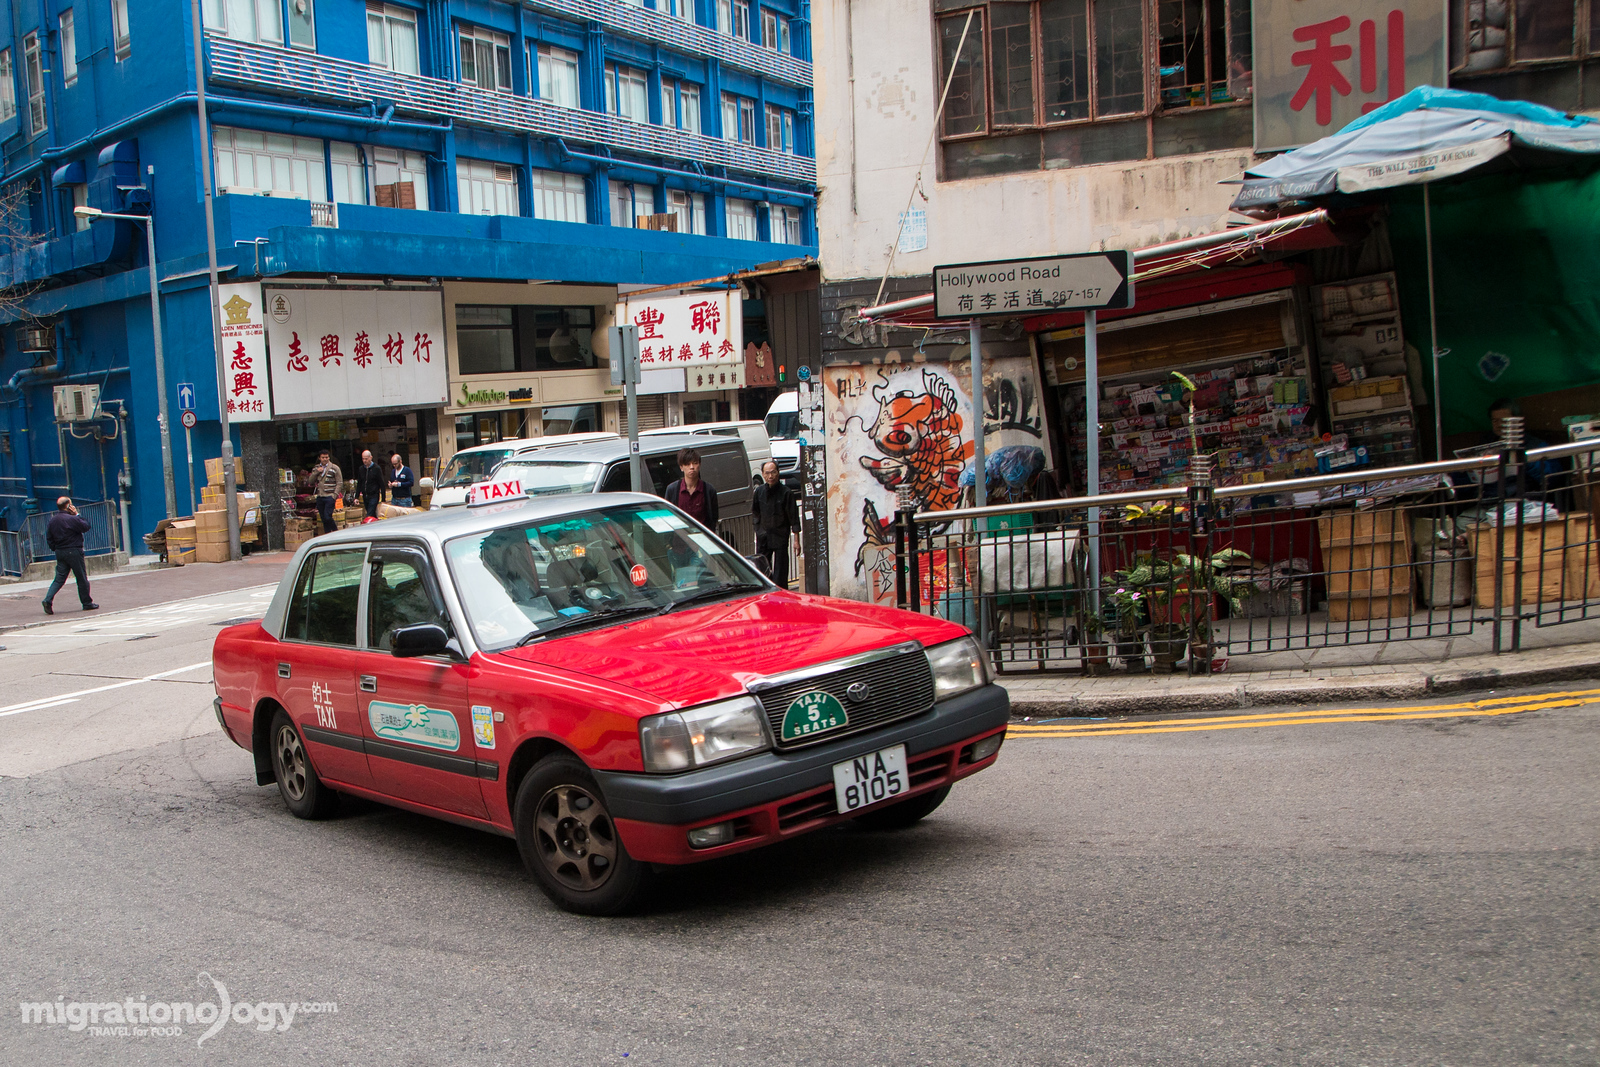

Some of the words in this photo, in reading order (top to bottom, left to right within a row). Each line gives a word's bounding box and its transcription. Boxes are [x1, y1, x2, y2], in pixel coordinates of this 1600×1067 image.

[1290, 9, 1405, 126] 利
[1367, 166, 1385, 177] THE
[1385, 161, 1407, 173] WALL
[1407, 155, 1439, 169] STREET
[1439, 148, 1477, 163] JOURNAL
[940, 269, 1016, 288] Hollywood
[1020, 265, 1061, 280] Road
[957, 288, 1044, 312] 荷李活道
[1051, 287, 1102, 302] 267-157
[287, 330, 433, 372] 志興藥材行
[230, 341, 258, 397] 志興
[227, 398, 265, 414] 藥材行
[480, 480, 522, 500] TAXI
[631, 570, 648, 582] TAXI
[312, 682, 333, 706] 的士
[796, 693, 828, 709] TAXI
[314, 704, 338, 730] TAXI
[808, 704, 821, 722] 5
[794, 717, 837, 735] SEATS
[853, 752, 887, 783] NA
[845, 770, 902, 810] 8105
